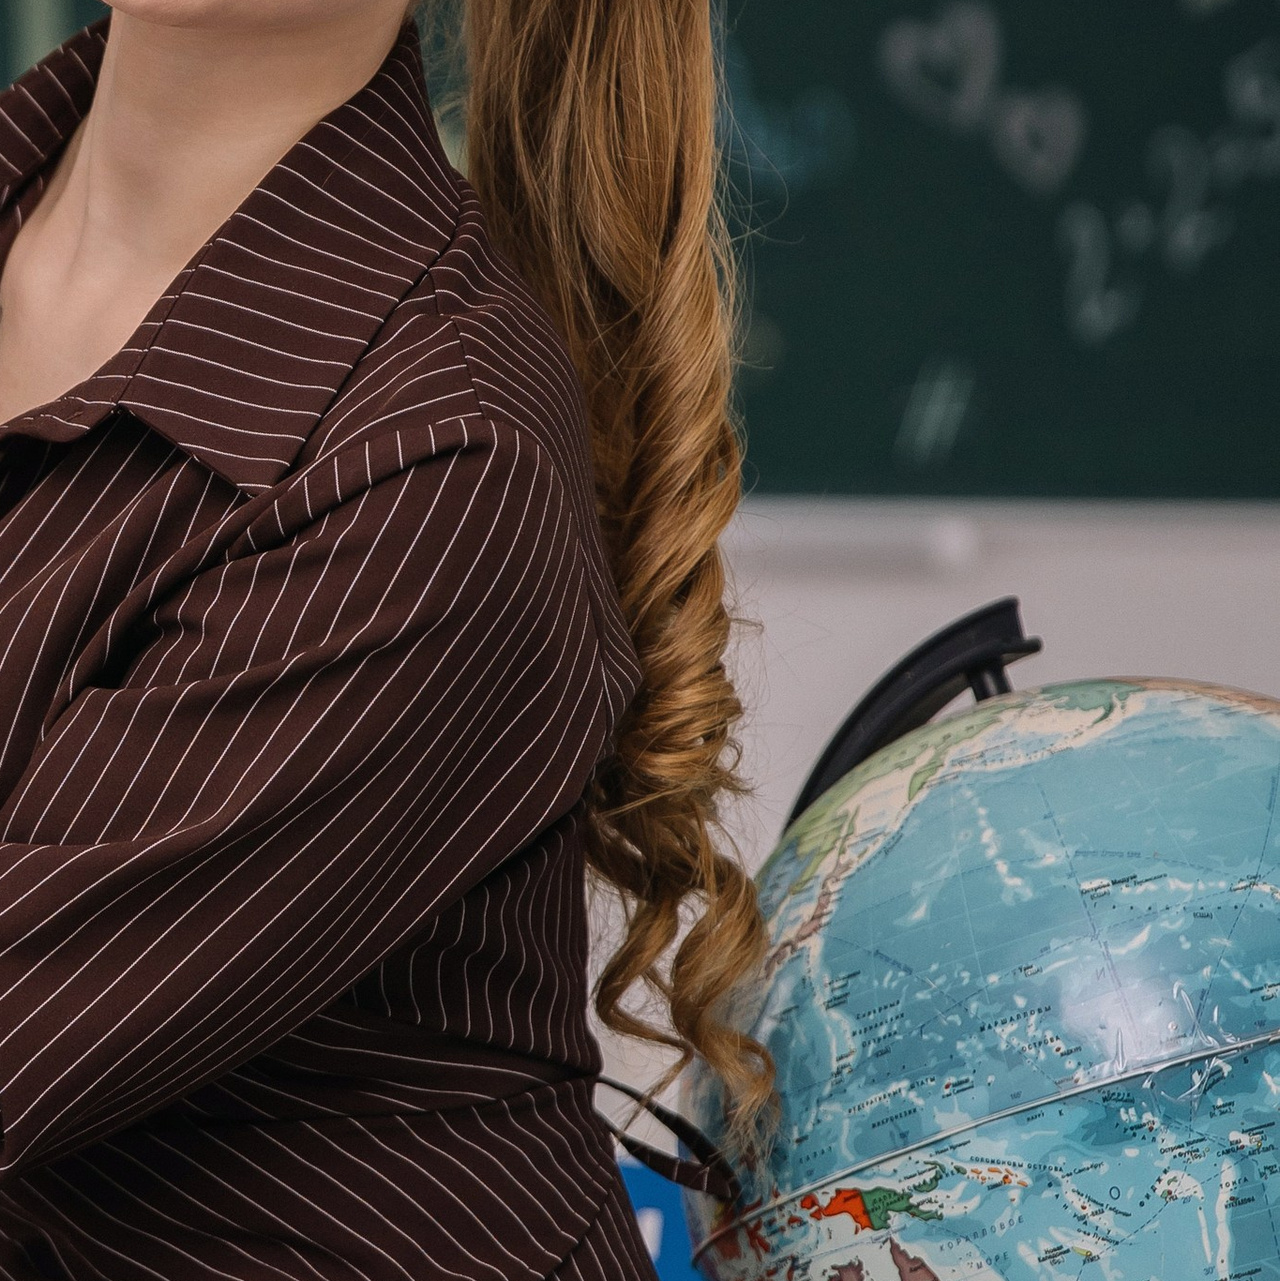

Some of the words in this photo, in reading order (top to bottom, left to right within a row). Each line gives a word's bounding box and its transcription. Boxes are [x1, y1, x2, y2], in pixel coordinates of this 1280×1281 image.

[1022, 1035, 1060, 1052] ОСТРОВА
[970, 1155, 1024, 1169] СОЛОМОНОВЫ
[1027, 1162, 1064, 1172] ОСТРОВА
[1219, 1177, 1248, 1189] ТОНГА
[940, 1215, 1024, 1252] КОРАЛЛОВОЕ
[1044, 1245, 1064, 1255] Новая
[976, 1251, 1009, 1270] МОРЕ
